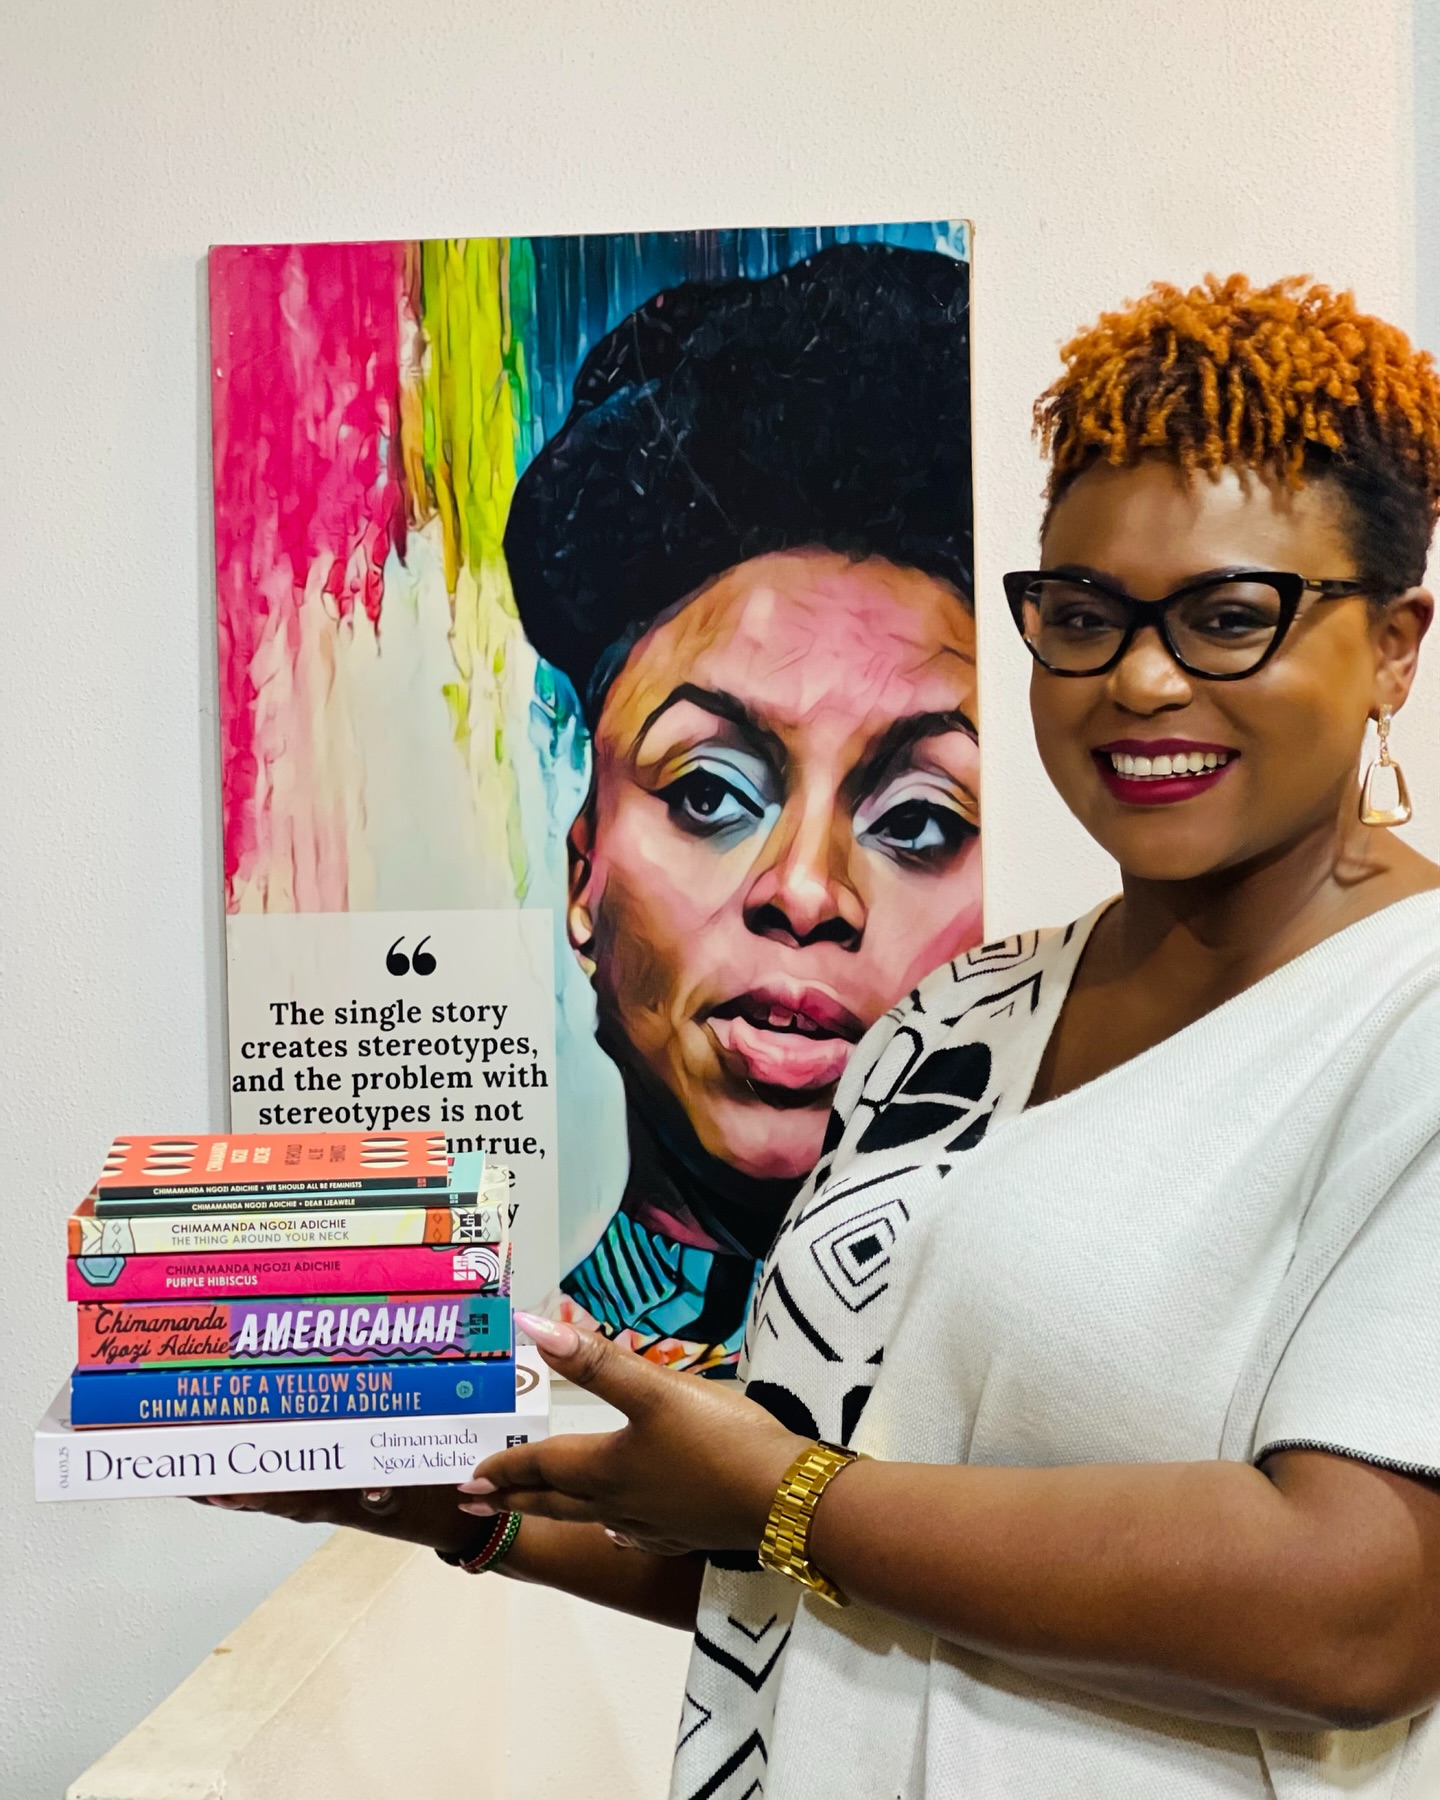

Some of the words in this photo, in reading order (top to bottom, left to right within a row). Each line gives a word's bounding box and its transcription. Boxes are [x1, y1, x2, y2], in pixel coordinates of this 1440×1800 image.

[270, 1002, 324, 1025] The
[335, 999, 422, 1031] single
[432, 1004, 508, 1030] story
[241, 1036, 348, 1059] creates
[358, 1035, 538, 1062] stereotypes,
[232, 1067, 285, 1092] and
[295, 1066, 342, 1090] the
[352, 1065, 473, 1097] problem
[483, 1063, 549, 1088] with
[259, 1102, 431, 1131] stereotypes
[441, 1097, 465, 1122] is
[475, 1100, 524, 1122] not
[153, 1186, 205, 1195] CHIMAMANDA
[230, 1185, 259, 1193] ADICHIE
[278, 1183, 305, 1191] SHOULD
[307, 1182, 318, 1190] ALL
[329, 1181, 362, 1189] FEMINISTS
[192, 1203, 243, 1211] CHIMAMANDA
[171, 1222, 256, 1234] CHIMAMANDA
[260, 1221, 296, 1231] NGOZI
[300, 1219, 347, 1229] ADICHIE
[171, 1236, 191, 1246] THE
[194, 1235, 228, 1245] THING
[232, 1234, 281, 1243] AROUND
[285, 1232, 315, 1242] YOUR
[319, 1231, 350, 1241] NECK
[166, 1263, 250, 1276] CHIMAMANDA
[254, 1262, 291, 1273] NGOZI
[294, 1261, 341, 1272] ADICHIE
[166, 1277, 204, 1288] PURPLE
[207, 1275, 258, 1287] HIBISCUS
[95, 1303, 227, 1334] Chimamanda
[235, 1305, 460, 1351] AMERICANAH
[91, 1336, 151, 1364] Ngozi
[157, 1335, 230, 1356] Adichie
[178, 1376, 223, 1397] HALF
[229, 1375, 252, 1395] OF
[258, 1375, 269, 1394] A
[276, 1373, 350, 1394] YELLOW
[356, 1372, 393, 1392] SUN
[139, 1396, 270, 1419] CHIMAMANDA
[281, 1393, 338, 1415] NGOZI
[346, 1392, 422, 1412] ADICHIE
[370, 1428, 478, 1448] Chimamanda
[85, 1449, 216, 1482] Dream
[228, 1442, 347, 1475] Count
[373, 1454, 415, 1474] Ngozi
[418, 1451, 476, 1469] Adichie
